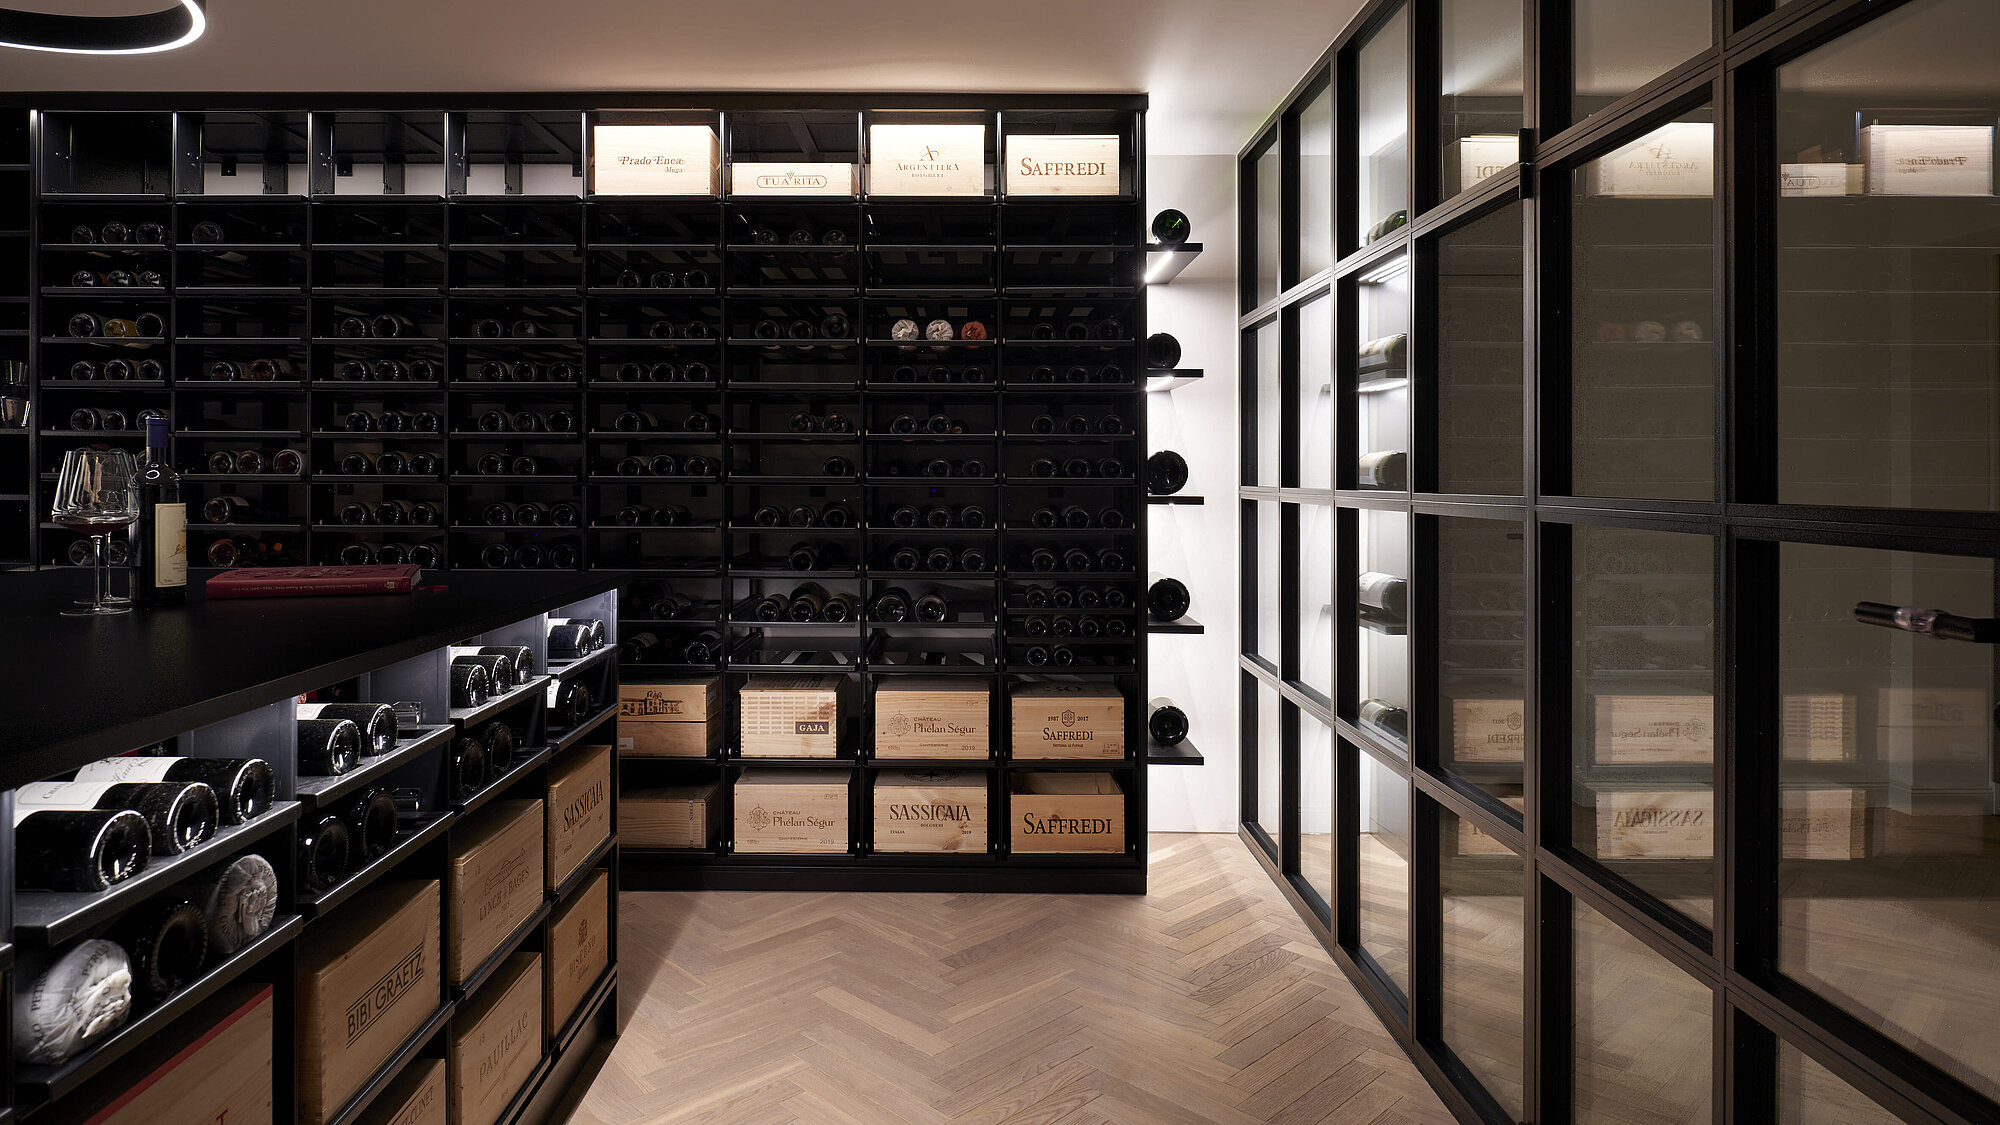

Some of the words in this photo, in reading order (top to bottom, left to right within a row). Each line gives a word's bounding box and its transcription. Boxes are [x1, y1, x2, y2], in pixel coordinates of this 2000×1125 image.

[617, 156, 652, 165] Prado
[1020, 157, 1106, 176] SAFFREDI
[799, 724, 825, 732] GAJA
[913, 722, 946, 733] Phélan
[947, 722, 977, 737] Ségur
[1042, 727, 1094, 741] SAFFREDI
[563, 780, 604, 832] SASSICAIA
[889, 804, 971, 821] SASSICAIA
[773, 817, 805, 827] Phélan
[806, 816, 836, 829] Ségur
[1023, 812, 1112, 835] SAFFREDI
[479, 890, 502, 921] LYNCH
[508, 866, 530, 896] BAGES
[347, 998, 371, 1038] BIBI
[375, 952, 424, 1010] GRAETZ
[479, 1011, 528, 1084] PAUILLAC
